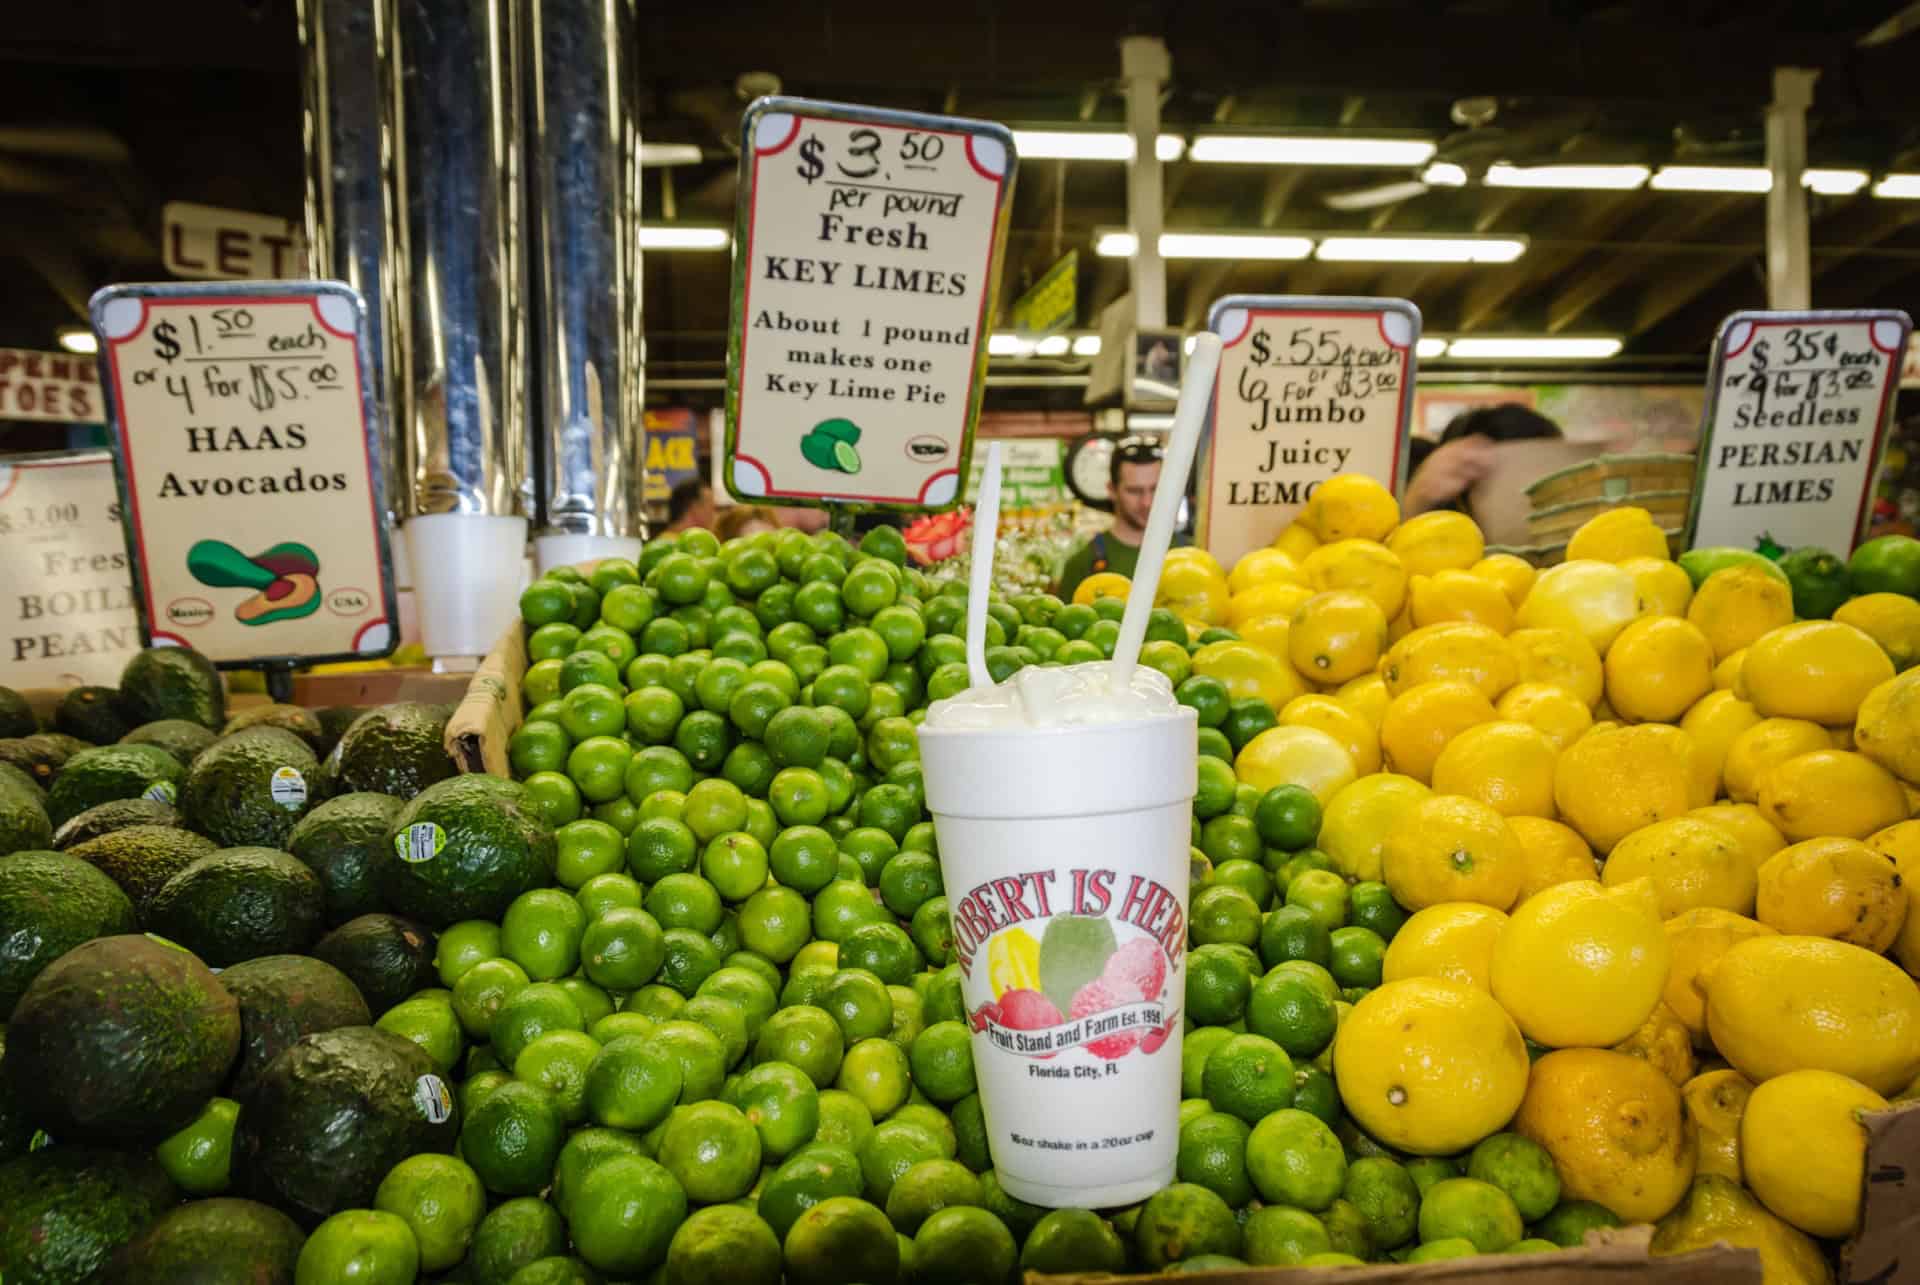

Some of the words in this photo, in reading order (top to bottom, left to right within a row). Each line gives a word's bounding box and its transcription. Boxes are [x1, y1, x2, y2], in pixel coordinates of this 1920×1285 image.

[828, 188, 871, 212] per
[883, 192, 965, 218] pound
[818, 213, 929, 250] Fresh
[765, 256, 842, 285] KEY
[854, 265, 967, 297] LIMES
[267, 323, 327, 351] each
[754, 310, 840, 335] About
[884, 321, 970, 346] pound
[787, 348, 874, 369] makes
[884, 356, 933, 374] one
[134, 367, 157, 385] or
[166, 374, 195, 415] 4
[203, 365, 242, 397] for
[765, 374, 818, 399] Key
[829, 379, 896, 401] Lime
[906, 384, 947, 405] Pie
[1238, 366, 1270, 403] 6
[1775, 371, 1803, 398] for
[1252, 398, 1366, 431] Jumbo
[1733, 401, 1860, 430] Seedless
[187, 424, 307, 453] HAAS
[1718, 439, 1864, 469] PERSIAN
[1259, 439, 1351, 473] Juicy
[159, 467, 347, 498] Avocados
[1732, 478, 1834, 506] LIMES
[41, 551, 128, 577] Fres
[11, 626, 131, 661] PEAN
[1071, 868, 1116, 917] IS
[989, 1022, 1015, 1049] Fruit
[1017, 1033, 1052, 1052] Stand
[1056, 1025, 1080, 1047] and
[1085, 1013, 1119, 1038] Farm
[1029, 1064, 1070, 1078] Florida
[1105, 1062, 1119, 1076] FL
[1037, 1138, 1073, 1151] shake
[1076, 1138, 1088, 1150] in
[1090, 1141, 1100, 1150] a
